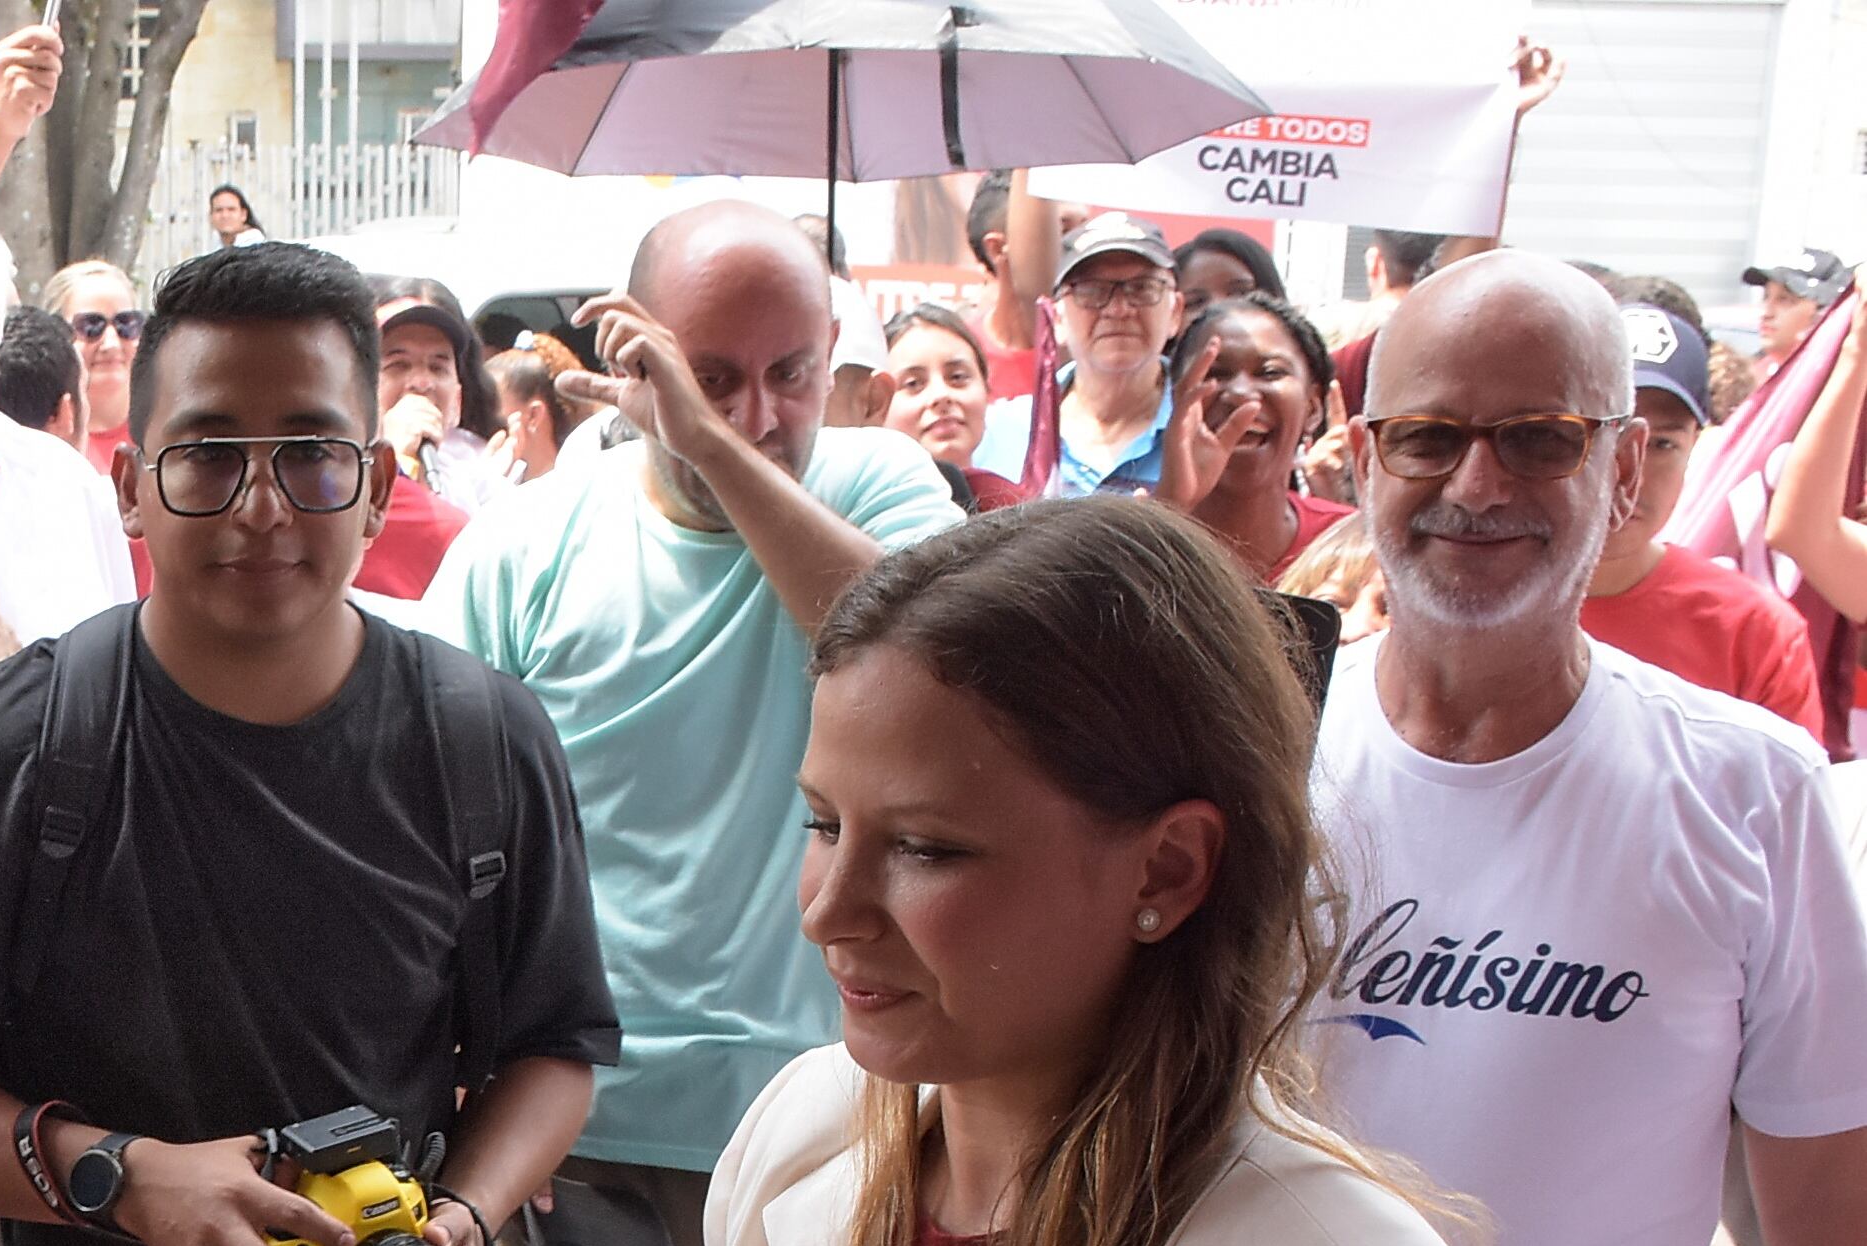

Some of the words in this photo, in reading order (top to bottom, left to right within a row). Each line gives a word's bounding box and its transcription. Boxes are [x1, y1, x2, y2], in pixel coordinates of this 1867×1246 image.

[1266, 117, 1367, 144] TODOS
[1197, 145, 1339, 180] CAMBIA
[1225, 177, 1307, 207] CALI
[1331, 898, 1650, 1024] leñísimo
